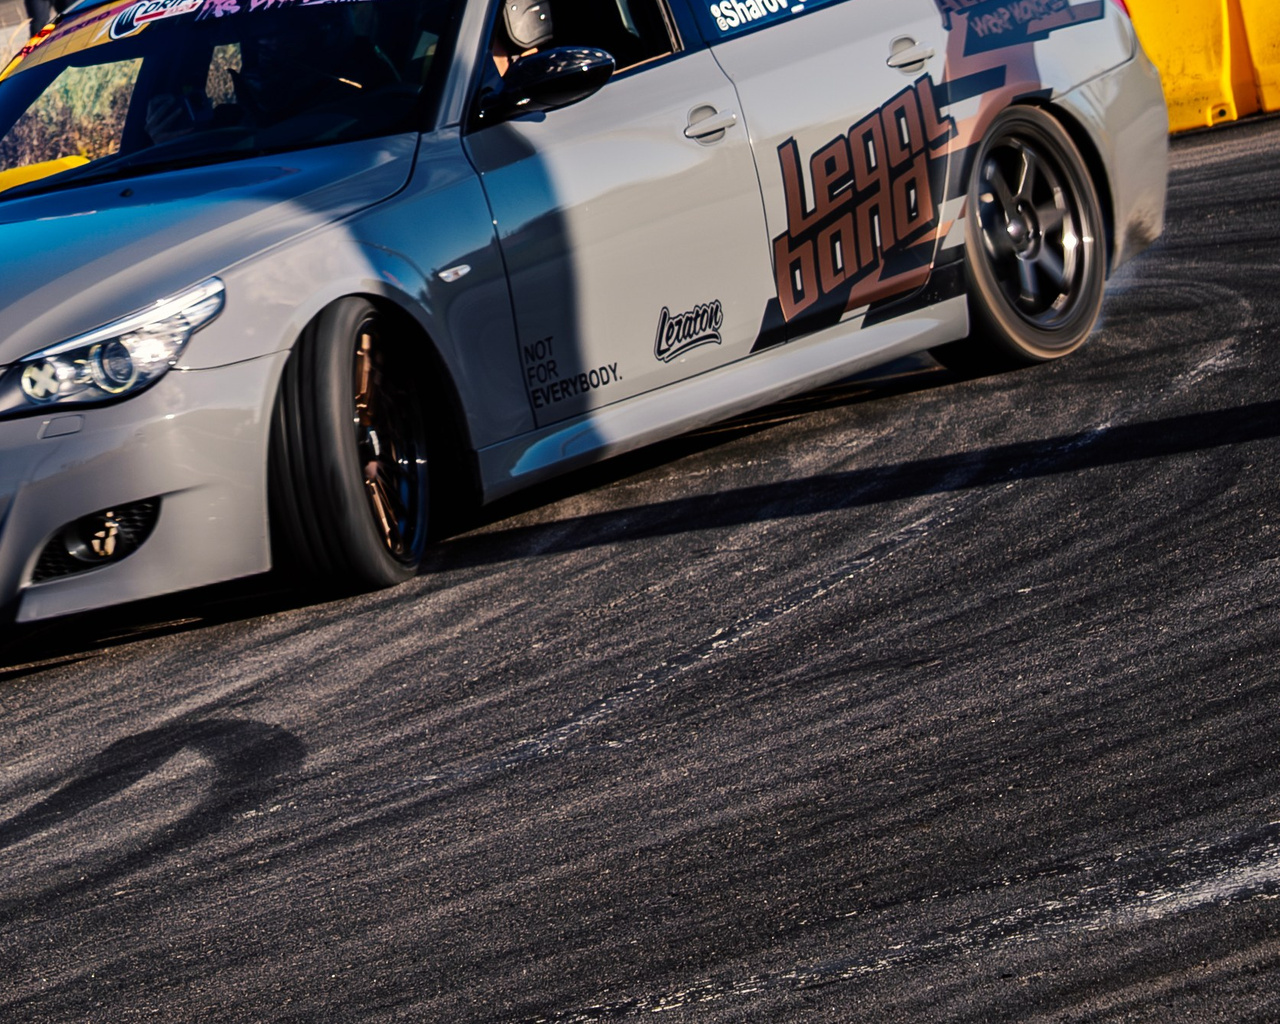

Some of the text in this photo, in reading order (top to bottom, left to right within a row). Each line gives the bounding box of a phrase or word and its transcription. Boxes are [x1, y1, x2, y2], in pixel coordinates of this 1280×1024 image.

[523, 335, 554, 365] NOT
[526, 358, 559, 388] FOR
[531, 361, 623, 409] EVERYBODY.
